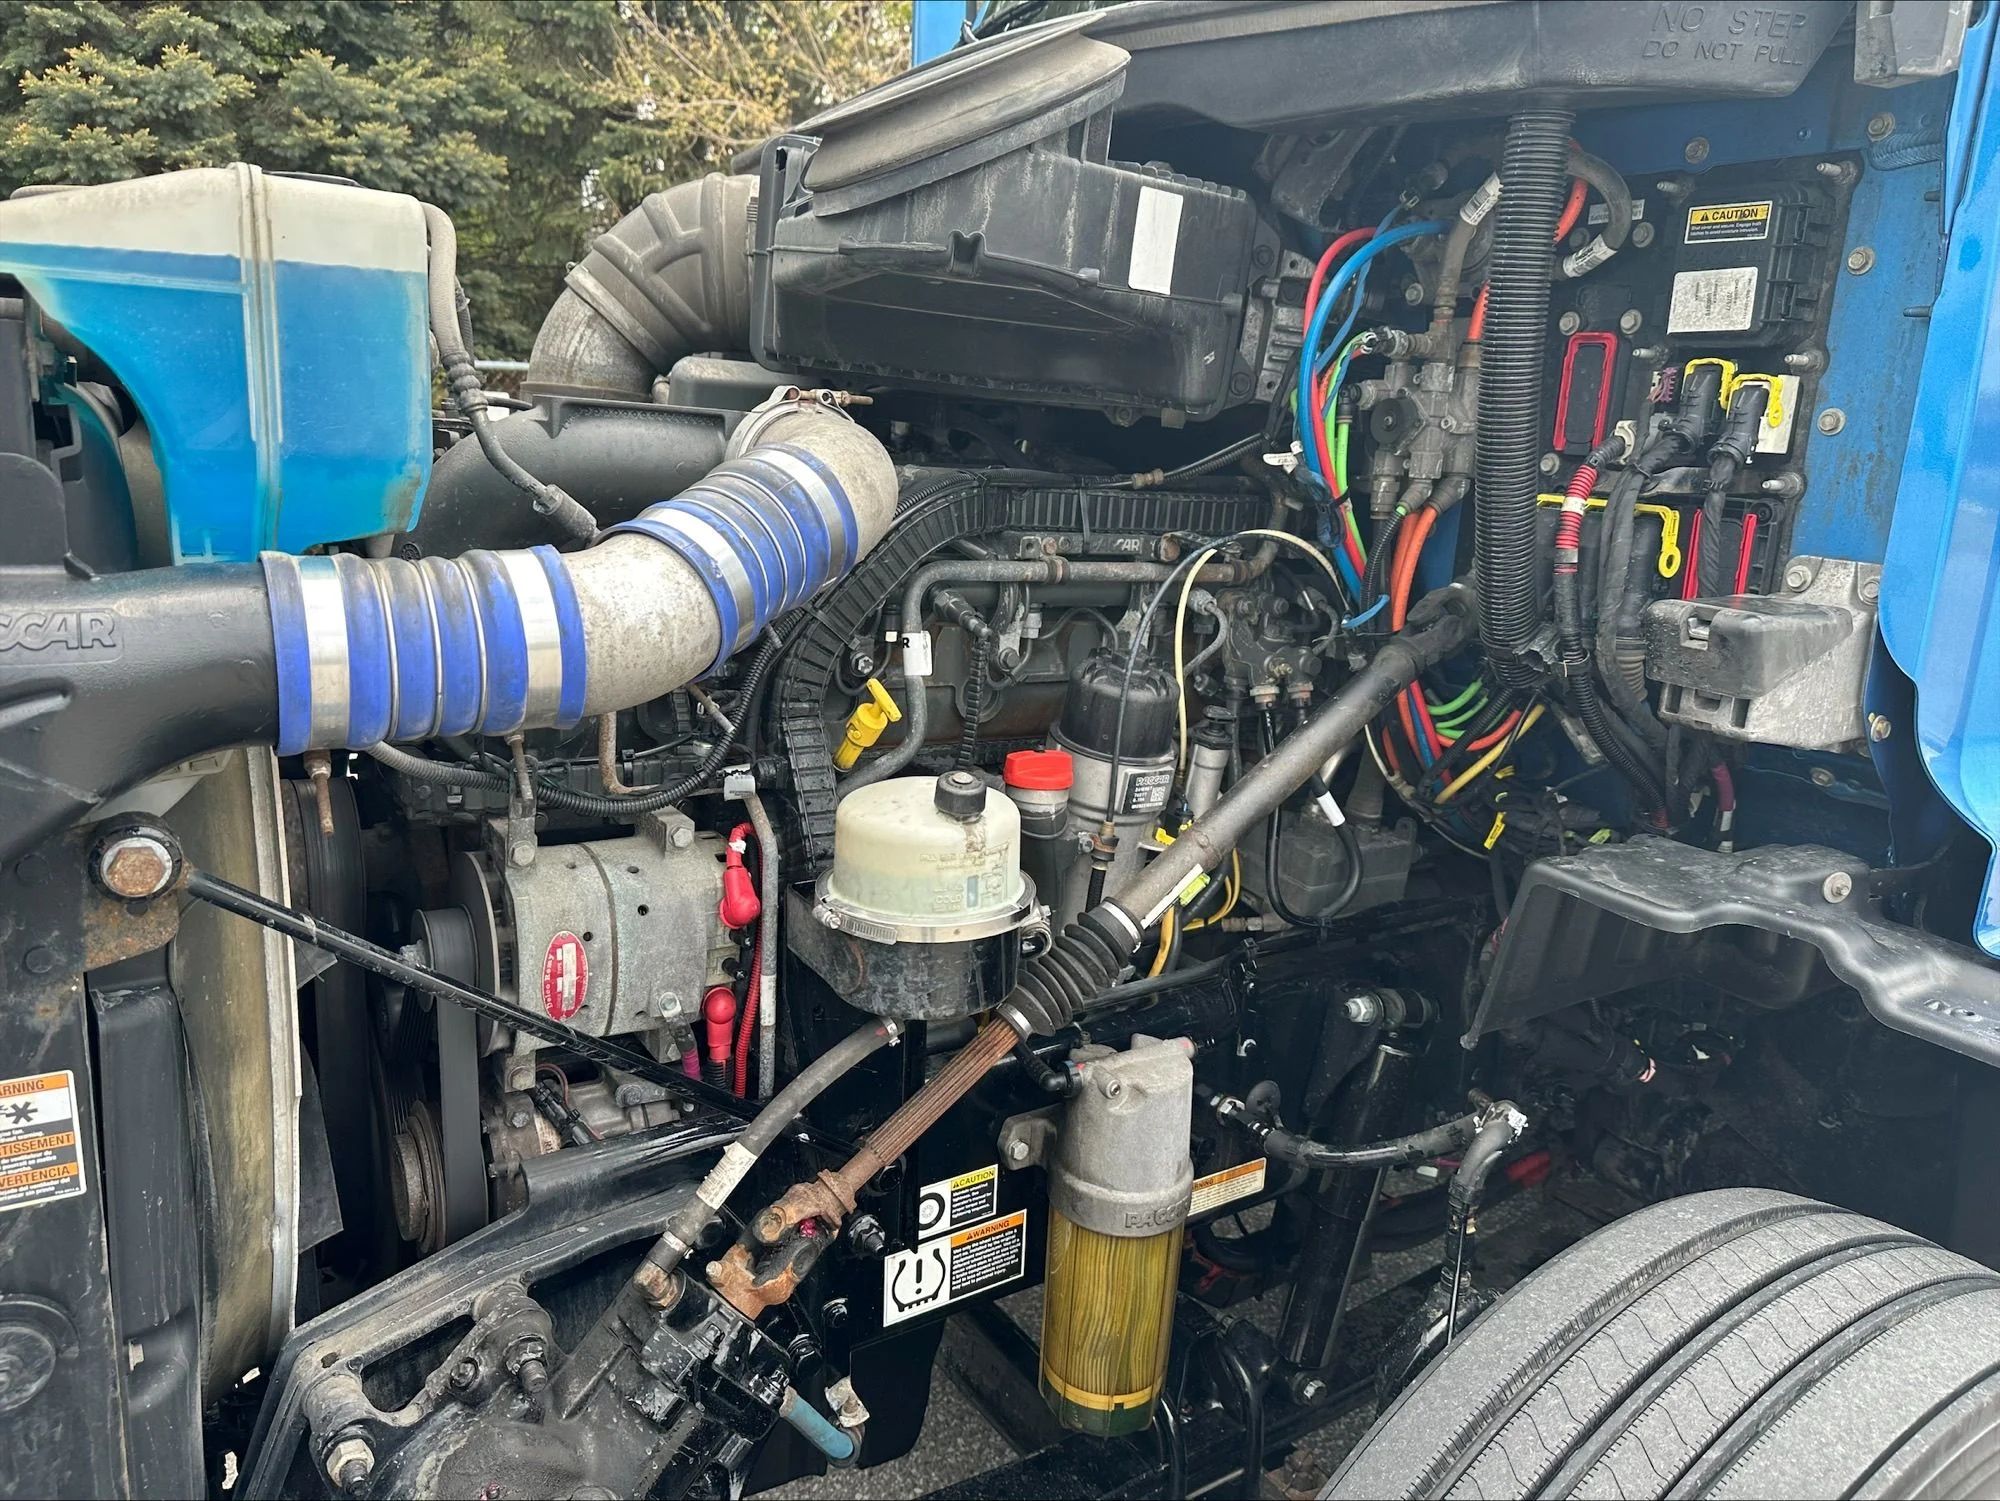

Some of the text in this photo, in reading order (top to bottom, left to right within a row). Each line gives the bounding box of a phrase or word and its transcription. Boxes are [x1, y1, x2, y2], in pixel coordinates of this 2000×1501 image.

[1651, 4, 1808, 39] NO STEP
[1642, 40, 1803, 65] DO NOT PULL
[1712, 208, 1758, 220] CAUTION
[960, 1170, 994, 1185] CAUTION
[972, 1221, 1009, 1237] WARNING
